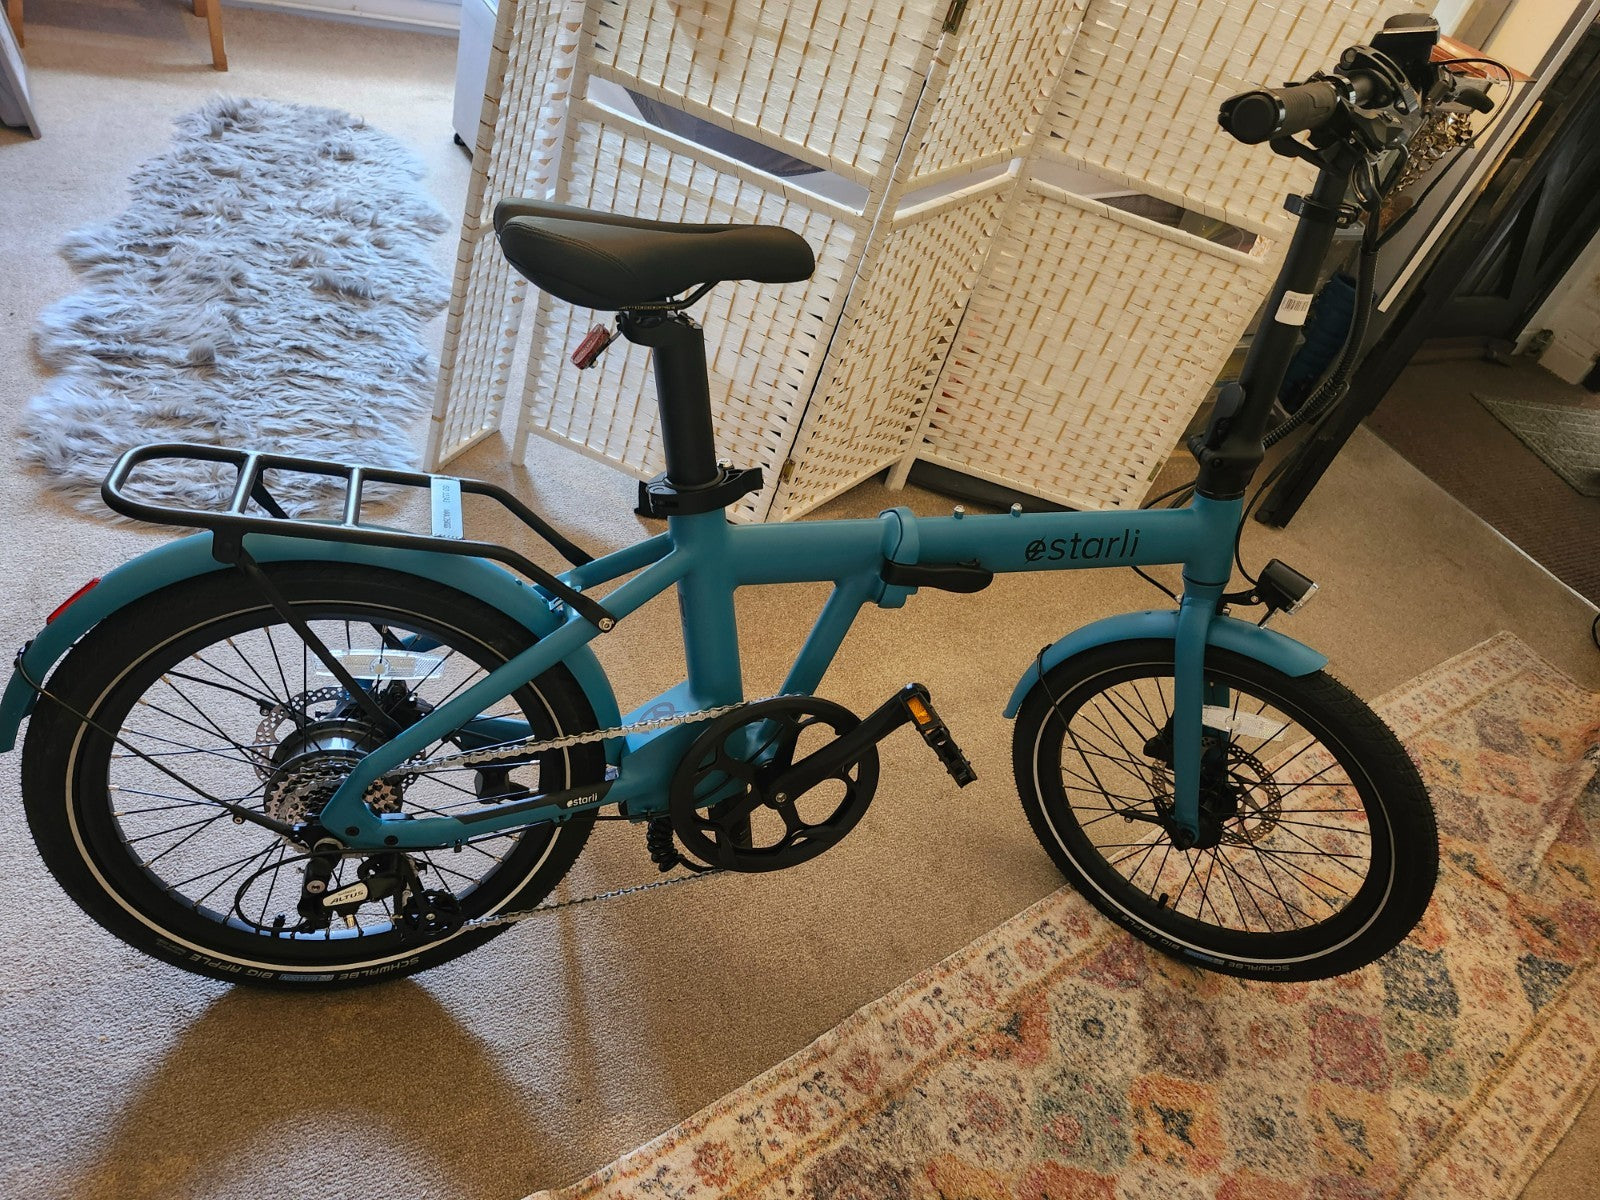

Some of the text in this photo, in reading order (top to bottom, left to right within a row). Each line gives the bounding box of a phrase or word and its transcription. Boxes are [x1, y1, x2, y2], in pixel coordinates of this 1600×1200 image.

[1024, 529, 1141, 565] estarli
[566, 792, 598, 808] estarli
[330, 890, 364, 904] ALTUS
[188, 953, 420, 981] SCHWALBE BIG APPLE
